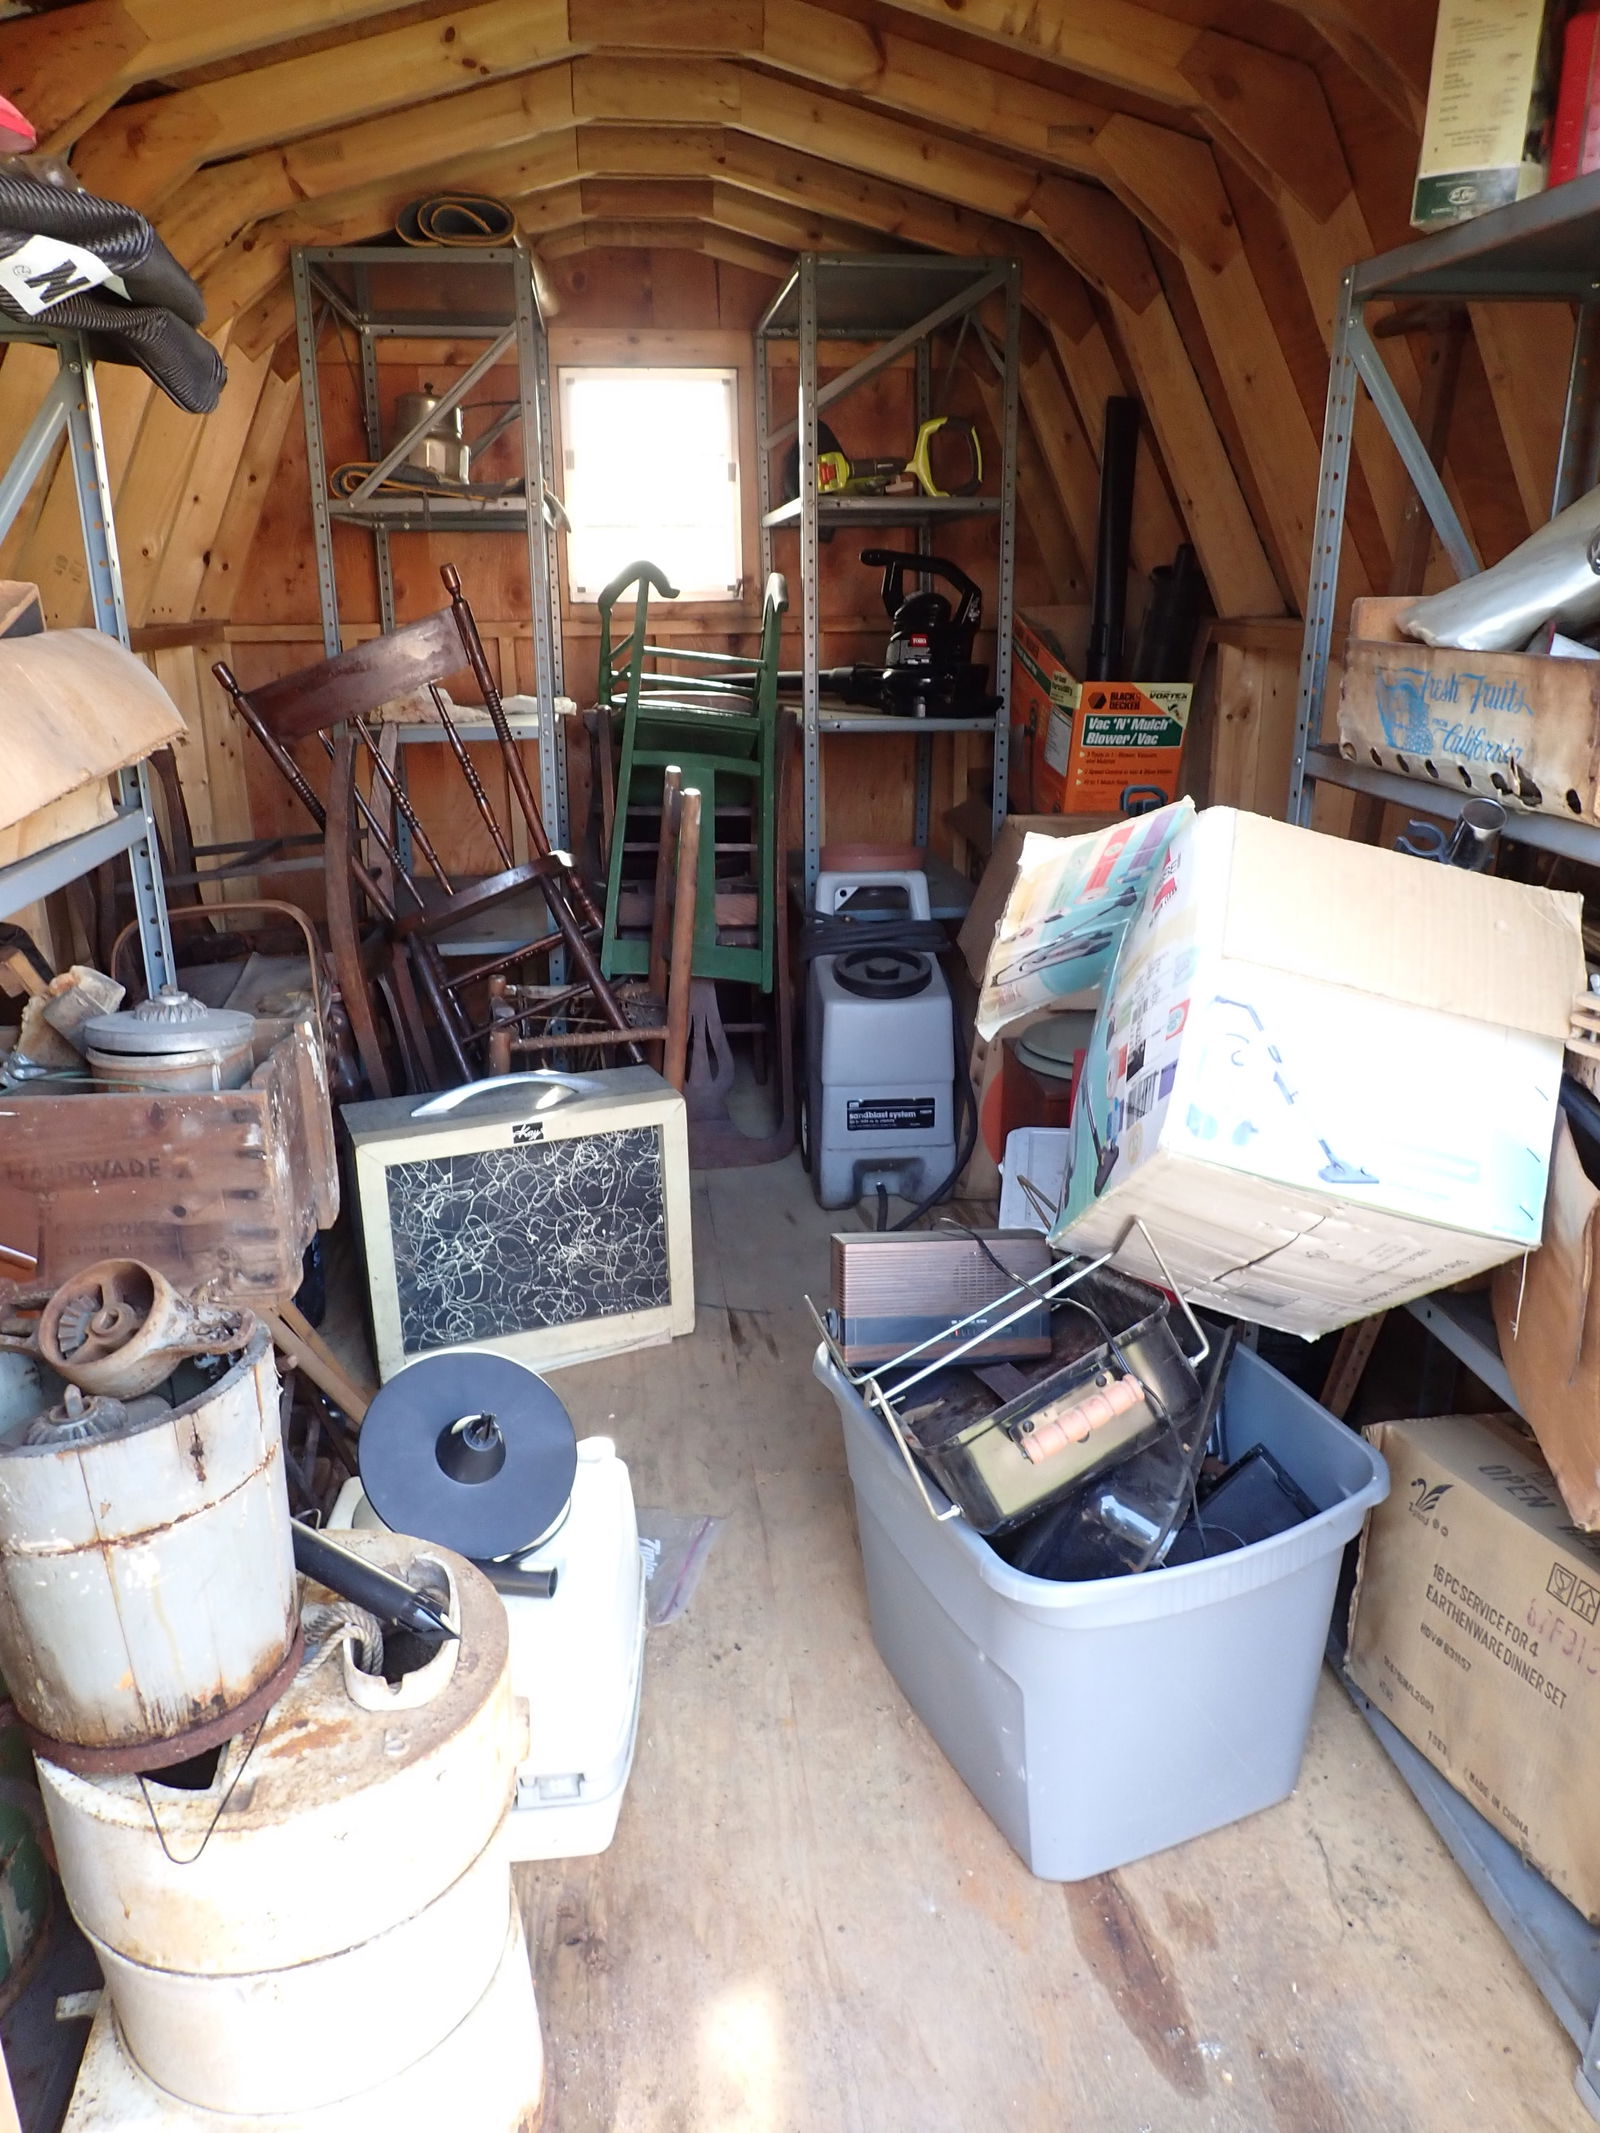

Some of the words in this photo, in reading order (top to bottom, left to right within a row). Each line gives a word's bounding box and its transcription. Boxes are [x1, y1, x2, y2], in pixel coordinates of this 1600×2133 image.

[1109, 701, 1140, 710] DECKER
[1149, 691, 1188, 700] VORTEX
[1402, 667, 1460, 704] Fresh
[1461, 672, 1534, 717] Fruits
[1088, 717, 1111, 730] Vac
[1130, 718, 1168, 731] Mulch
[849, 1110, 888, 1120] sandblast
[889, 1110, 917, 1120] system
[1478, 1464, 1557, 1508] OPEN
[1459, 1585, 1505, 1631] SERVICE
[1504, 1620, 1528, 1651] FOR
[1529, 1641, 1539, 1658] 4
[1426, 1583, 1504, 1660] EARTHENWARE
[1503, 1647, 1544, 1693] DINNER
[1544, 1681, 1567, 1710] SET
